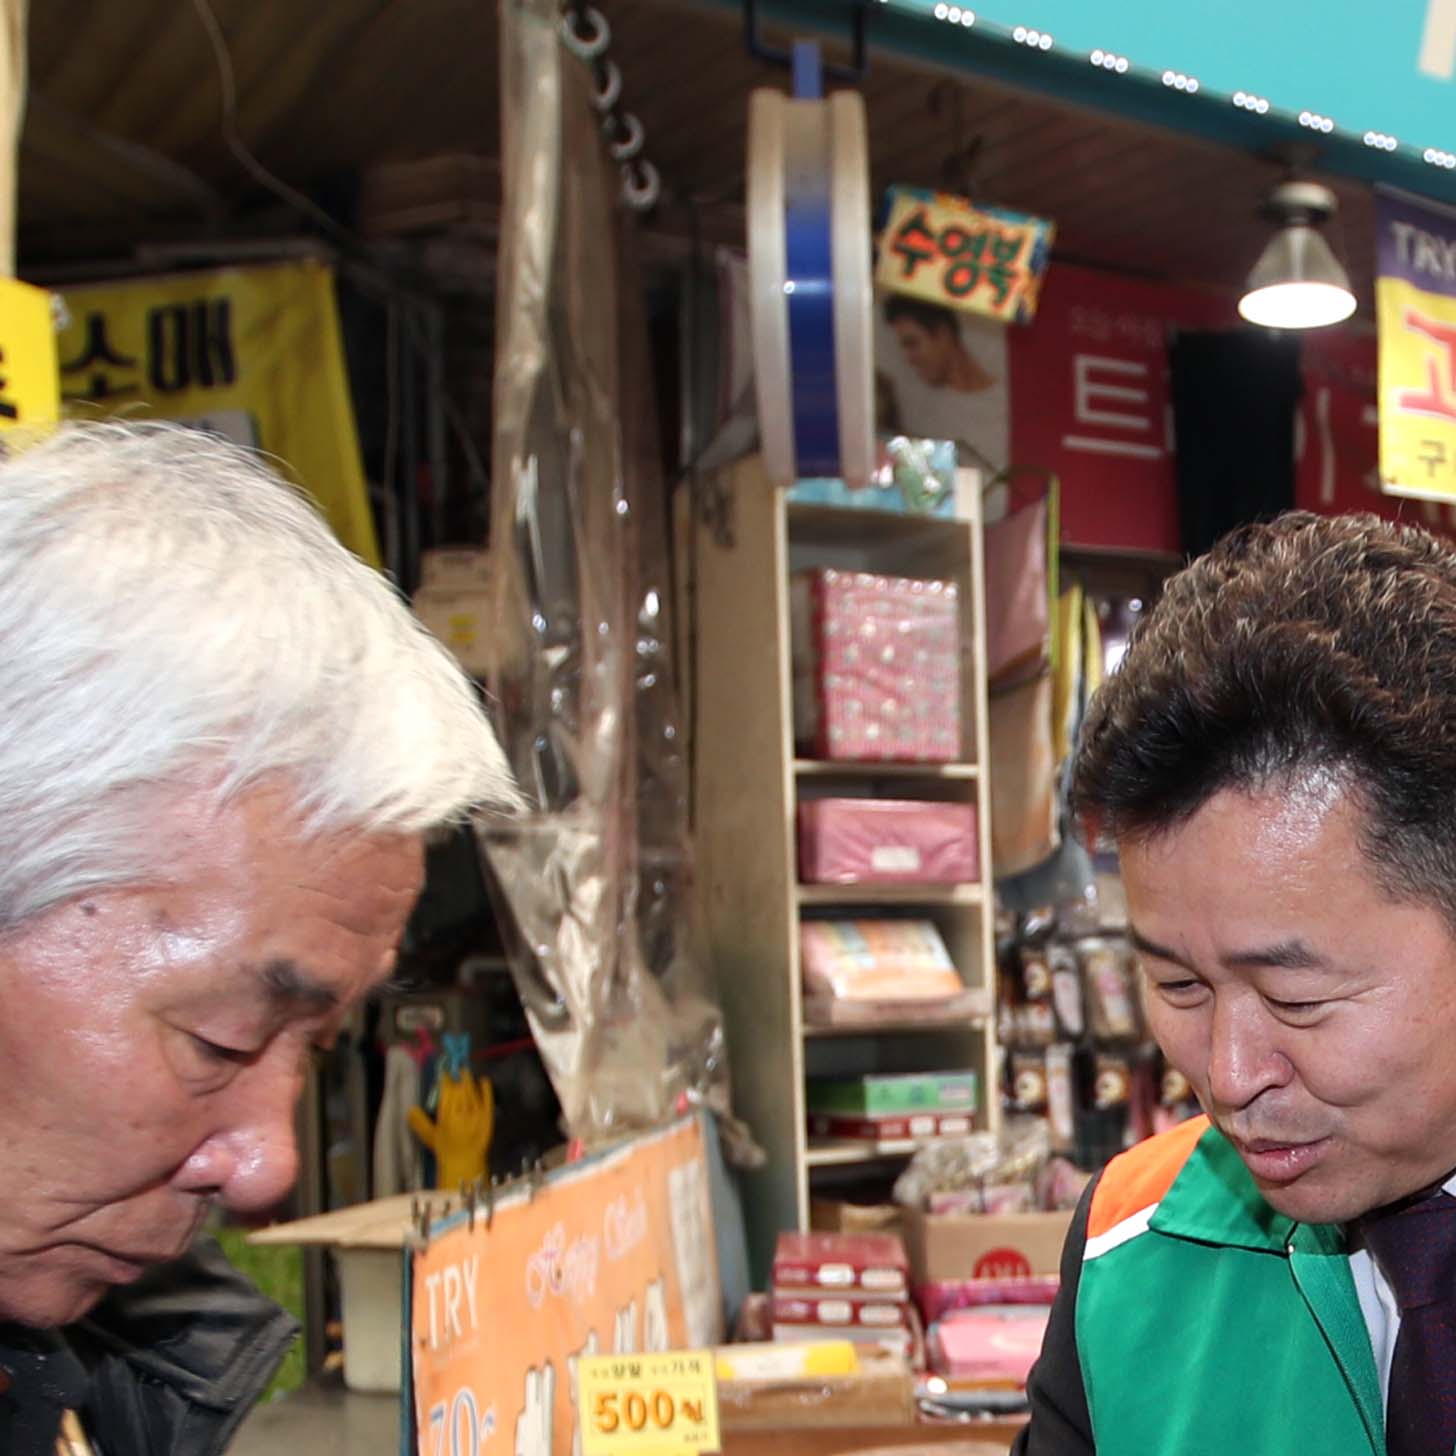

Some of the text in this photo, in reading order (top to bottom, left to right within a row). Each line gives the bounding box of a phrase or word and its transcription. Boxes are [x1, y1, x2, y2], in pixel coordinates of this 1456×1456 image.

[891, 212, 1030, 310] 수영복
[60, 299, 240, 398] 소매
[425, 1254, 479, 1350] TRY
